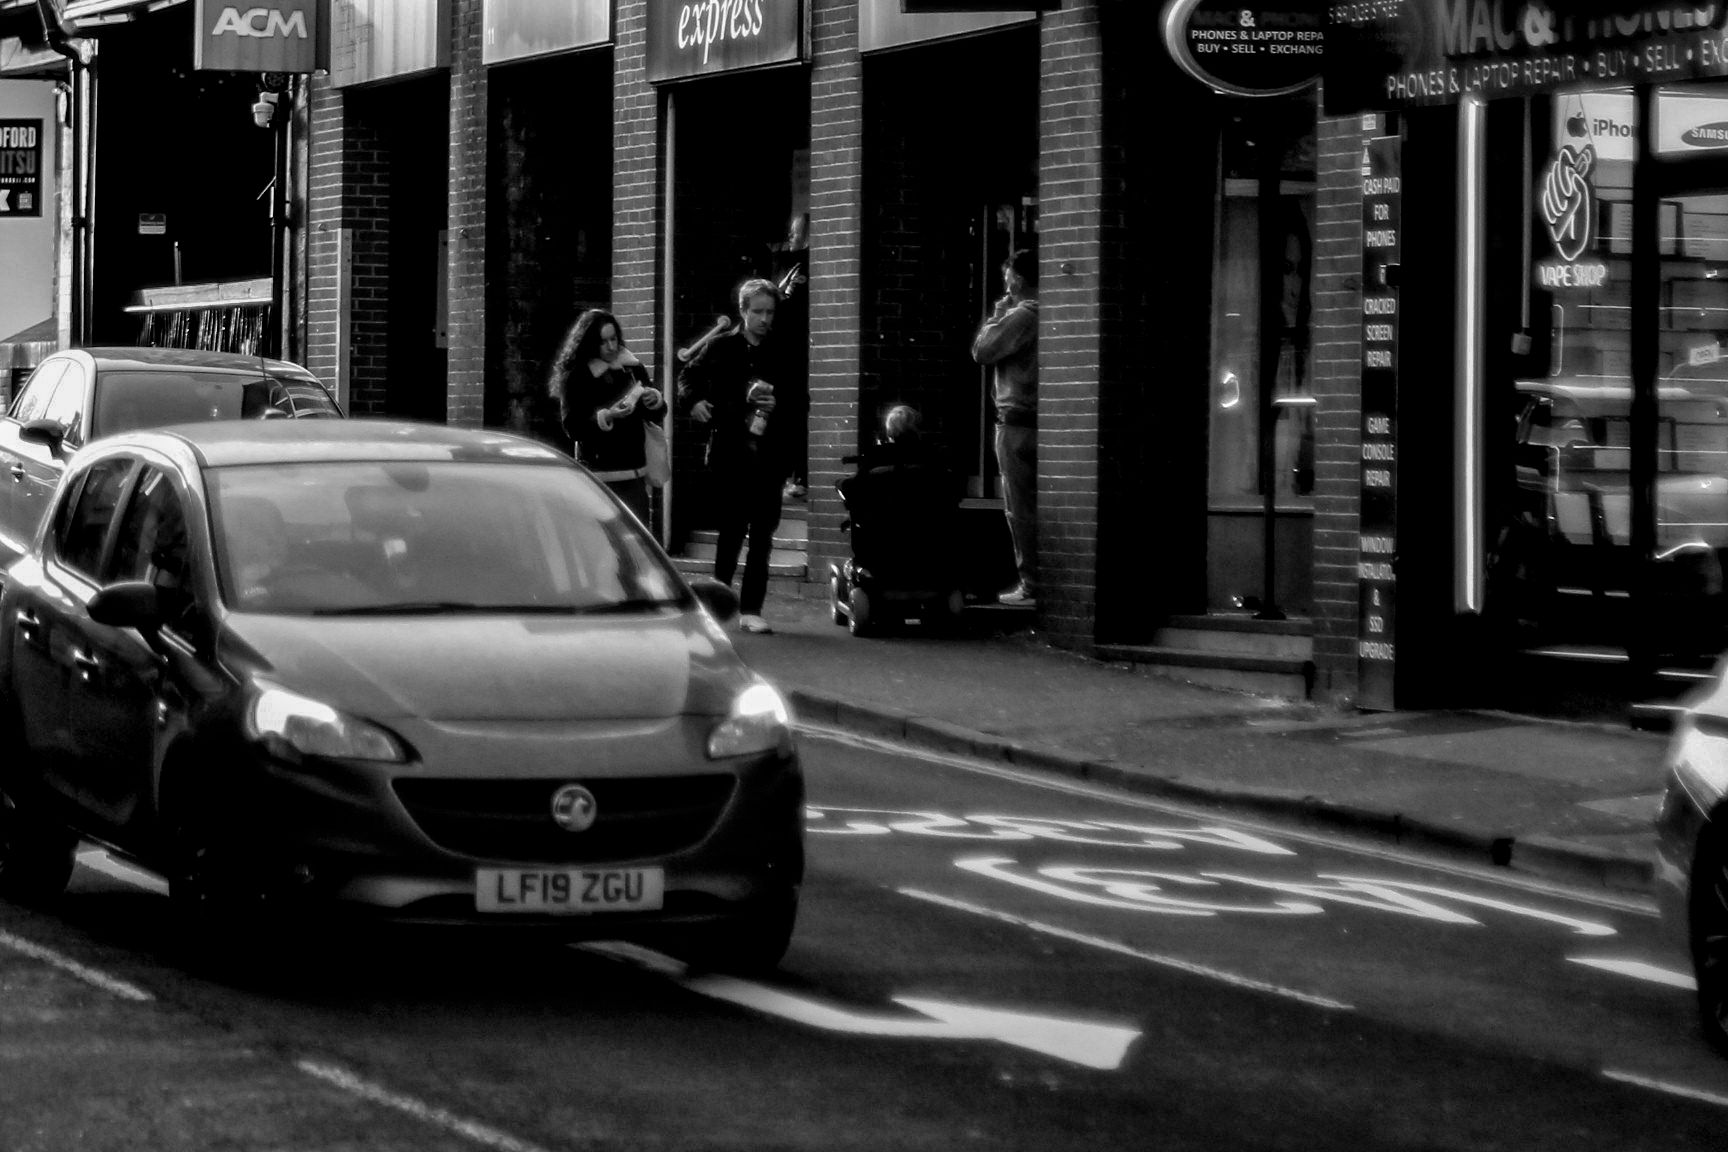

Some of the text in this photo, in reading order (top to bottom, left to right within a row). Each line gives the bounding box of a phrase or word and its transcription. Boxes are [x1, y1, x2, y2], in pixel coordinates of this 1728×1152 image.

[212, 7, 308, 38] ACM
[1240, 9, 1256, 28] &
[1191, 30, 1237, 41] PHONES
[1240, 30, 1250, 41] &
[1252, 30, 1294, 41] LAPTOP
[1197, 43, 1220, 54] BUY
[1232, 44, 1256, 54] SELL
[1387, 70, 1445, 99] PHONES
[1449, 68, 1460, 94] &
[1465, 61, 1519, 92] LAPTOP
[1524, 54, 1575, 85] REPAIR
[1597, 50, 1627, 78] BUY
[1646, 45, 1680, 73] SELL
[1363, 177, 1401, 195] CASH PAID
[1374, 203, 1390, 221] FOR
[1366, 229, 1396, 248] PHONES
[1541, 264, 1605, 286] VAPE SHOP
[1364, 297, 1396, 315] CRACKED
[1366, 324, 1393, 341] SCREEN
[1366, 350, 1392, 367] REPAIR
[1362, 443, 1394, 461] CONSOLE
[1366, 469, 1391, 487] REPAIR
[1359, 641, 1395, 661] UPGRADE
[497, 871, 644, 905] LF19 ZGU
